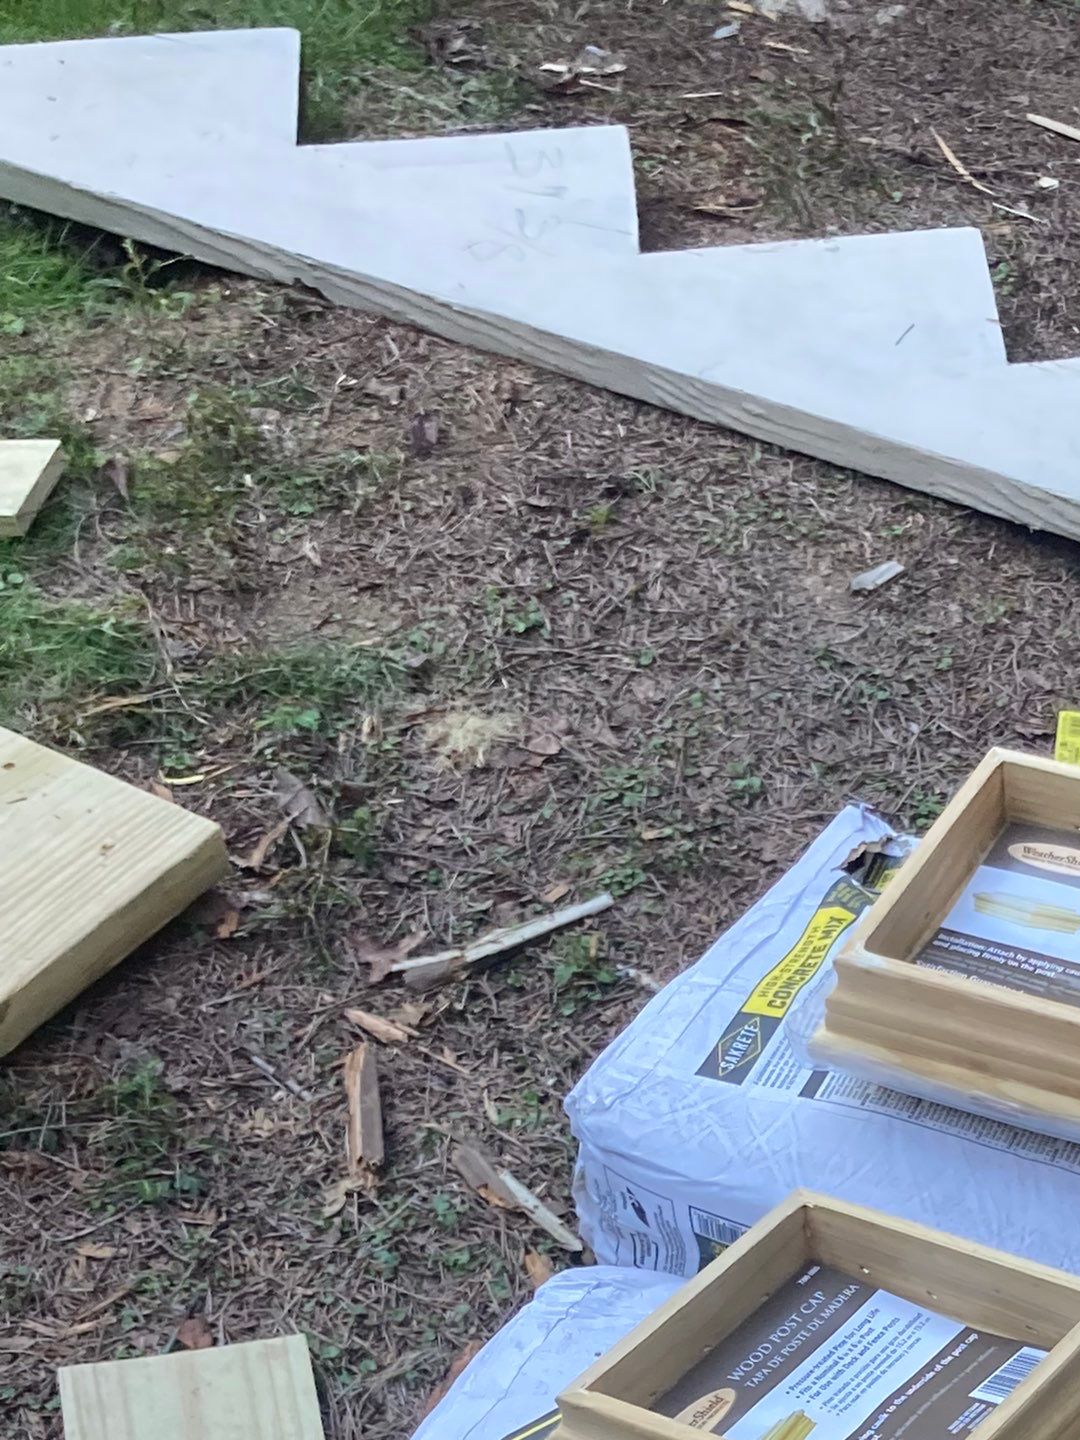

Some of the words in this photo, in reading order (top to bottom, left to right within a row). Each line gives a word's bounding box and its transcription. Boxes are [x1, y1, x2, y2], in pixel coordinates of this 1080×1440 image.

[767, 943, 827, 1010] CONCRETE
[818, 915, 848, 945] MIX
[932, 940, 950, 950] and
[948, 943, 981, 957] placing
[981, 952, 1005, 965] firmly
[1007, 959, 1019, 967] on
[1020, 963, 1034, 972] the
[987, 946, 1015, 959] Attach
[1015, 953, 1028, 963] by
[1028, 958, 1064, 973] applying
[720, 1023, 759, 1071] SAKRETE
[727, 1343, 772, 1383] WOOD
[772, 1313, 803, 1343] POST
[800, 1291, 826, 1314] CAP
[744, 1369, 772, 1389] TAPA
[768, 1354, 786, 1369] DE
[781, 1329, 812, 1357] POSTE
[807, 1316, 825, 1330] DE
[820, 1284, 861, 1319] MADERA
[787, 1349, 836, 1392] Pressure-treated
[852, 1317, 871, 1332] Long
[865, 1307, 880, 1318] Life
[798, 1384, 813, 1396] Fits
[814, 1358, 840, 1381] Nominal
[858, 1326, 875, 1340] Post
[809, 1390, 822, 1401] For
[819, 1379, 833, 1391] Use
[830, 1367, 846, 1381] with
[842, 1355, 859, 1369] Deck
[856, 1345, 870, 1356] and
[871, 1413, 889, 1429] caulk
[885, 1405, 897, 1413] to
[893, 1395, 908, 1405] the
[905, 1371, 936, 1395] underside
[940, 1355, 955, 1365] the
[951, 1343, 968, 1357] post
[964, 1333, 979, 1344] cap
